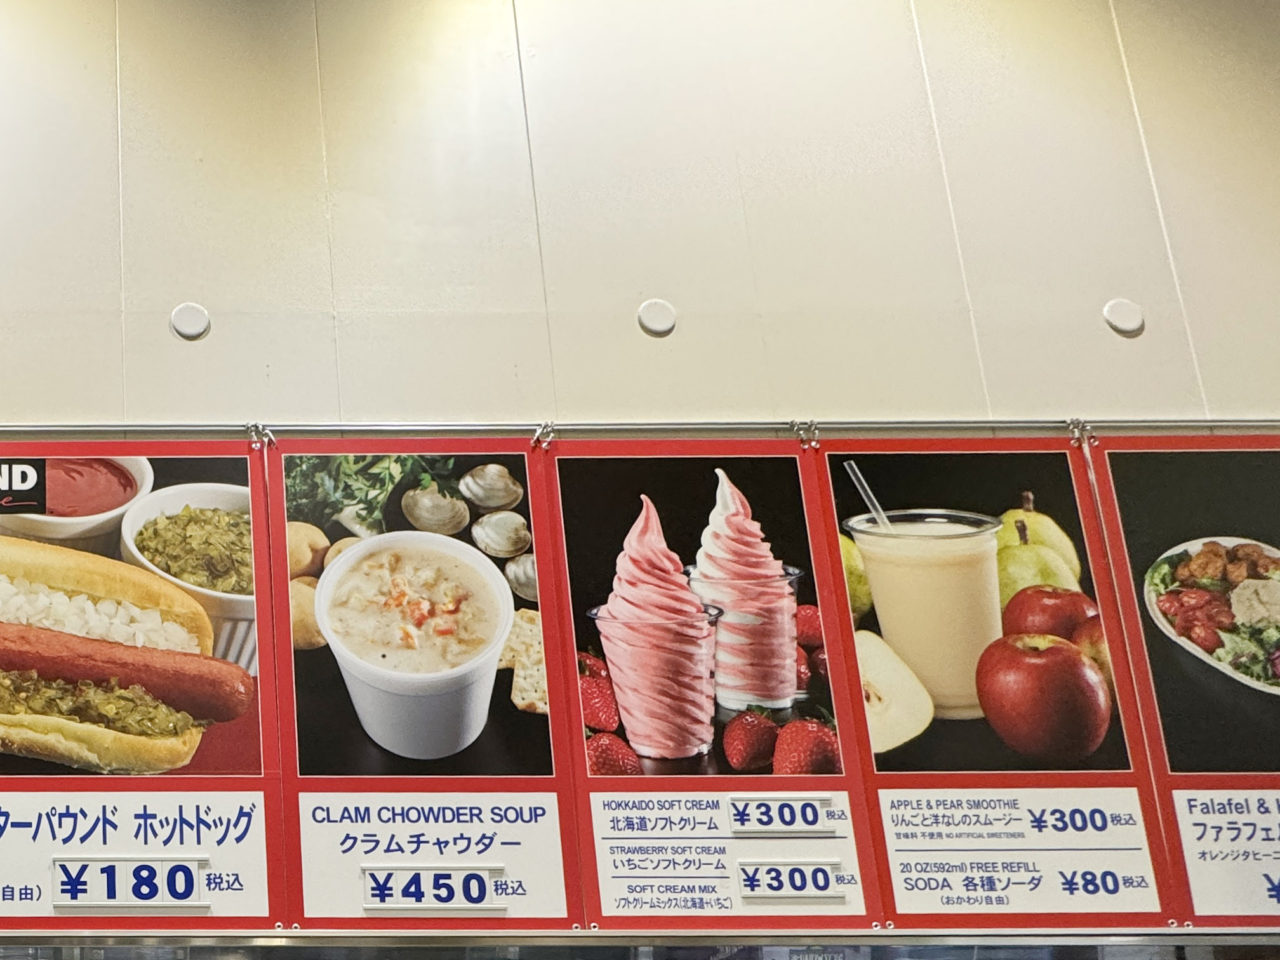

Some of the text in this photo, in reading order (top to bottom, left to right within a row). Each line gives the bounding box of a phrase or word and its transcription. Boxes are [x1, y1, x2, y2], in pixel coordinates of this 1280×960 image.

[603, 800, 720, 810] HOKKAIDO SOFT CREAM
[890, 799, 1019, 810] APPLE & PEAR SMOOTHIE
[1187, 798, 1251, 814] Falafel
[1257, 798, 1271, 814] &
[312, 807, 546, 823] CLAM CHOWDER SOUP
[731, 802, 847, 826] ¥300 税込
[892, 814, 1022, 827] りんごと洋なしのスムージー
[1028, 808, 1136, 833] ¥300 税込
[134, 803, 256, 846] ホットドッグ
[610, 816, 718, 831] 北海道ソフトクリーム
[340, 832, 521, 855] クラムチャウダー
[610, 846, 726, 855] STRAWBERRY SOFT CREAM
[613, 858, 726, 870] いちごソフトクリーム
[900, 863, 912, 873] 20
[970, 862, 1002, 872] FREE
[1001, 862, 1040, 872] REFILL
[59, 864, 243, 900] ¥180 税込
[741, 867, 857, 891] ¥300 税込
[904, 876, 1042, 891] SODA 各種ソーダ
[1059, 870, 1149, 895] ¥80 税込
[369, 873, 526, 904] ¥450 税込
[627, 885, 717, 893] SOFT CREAM MIX
